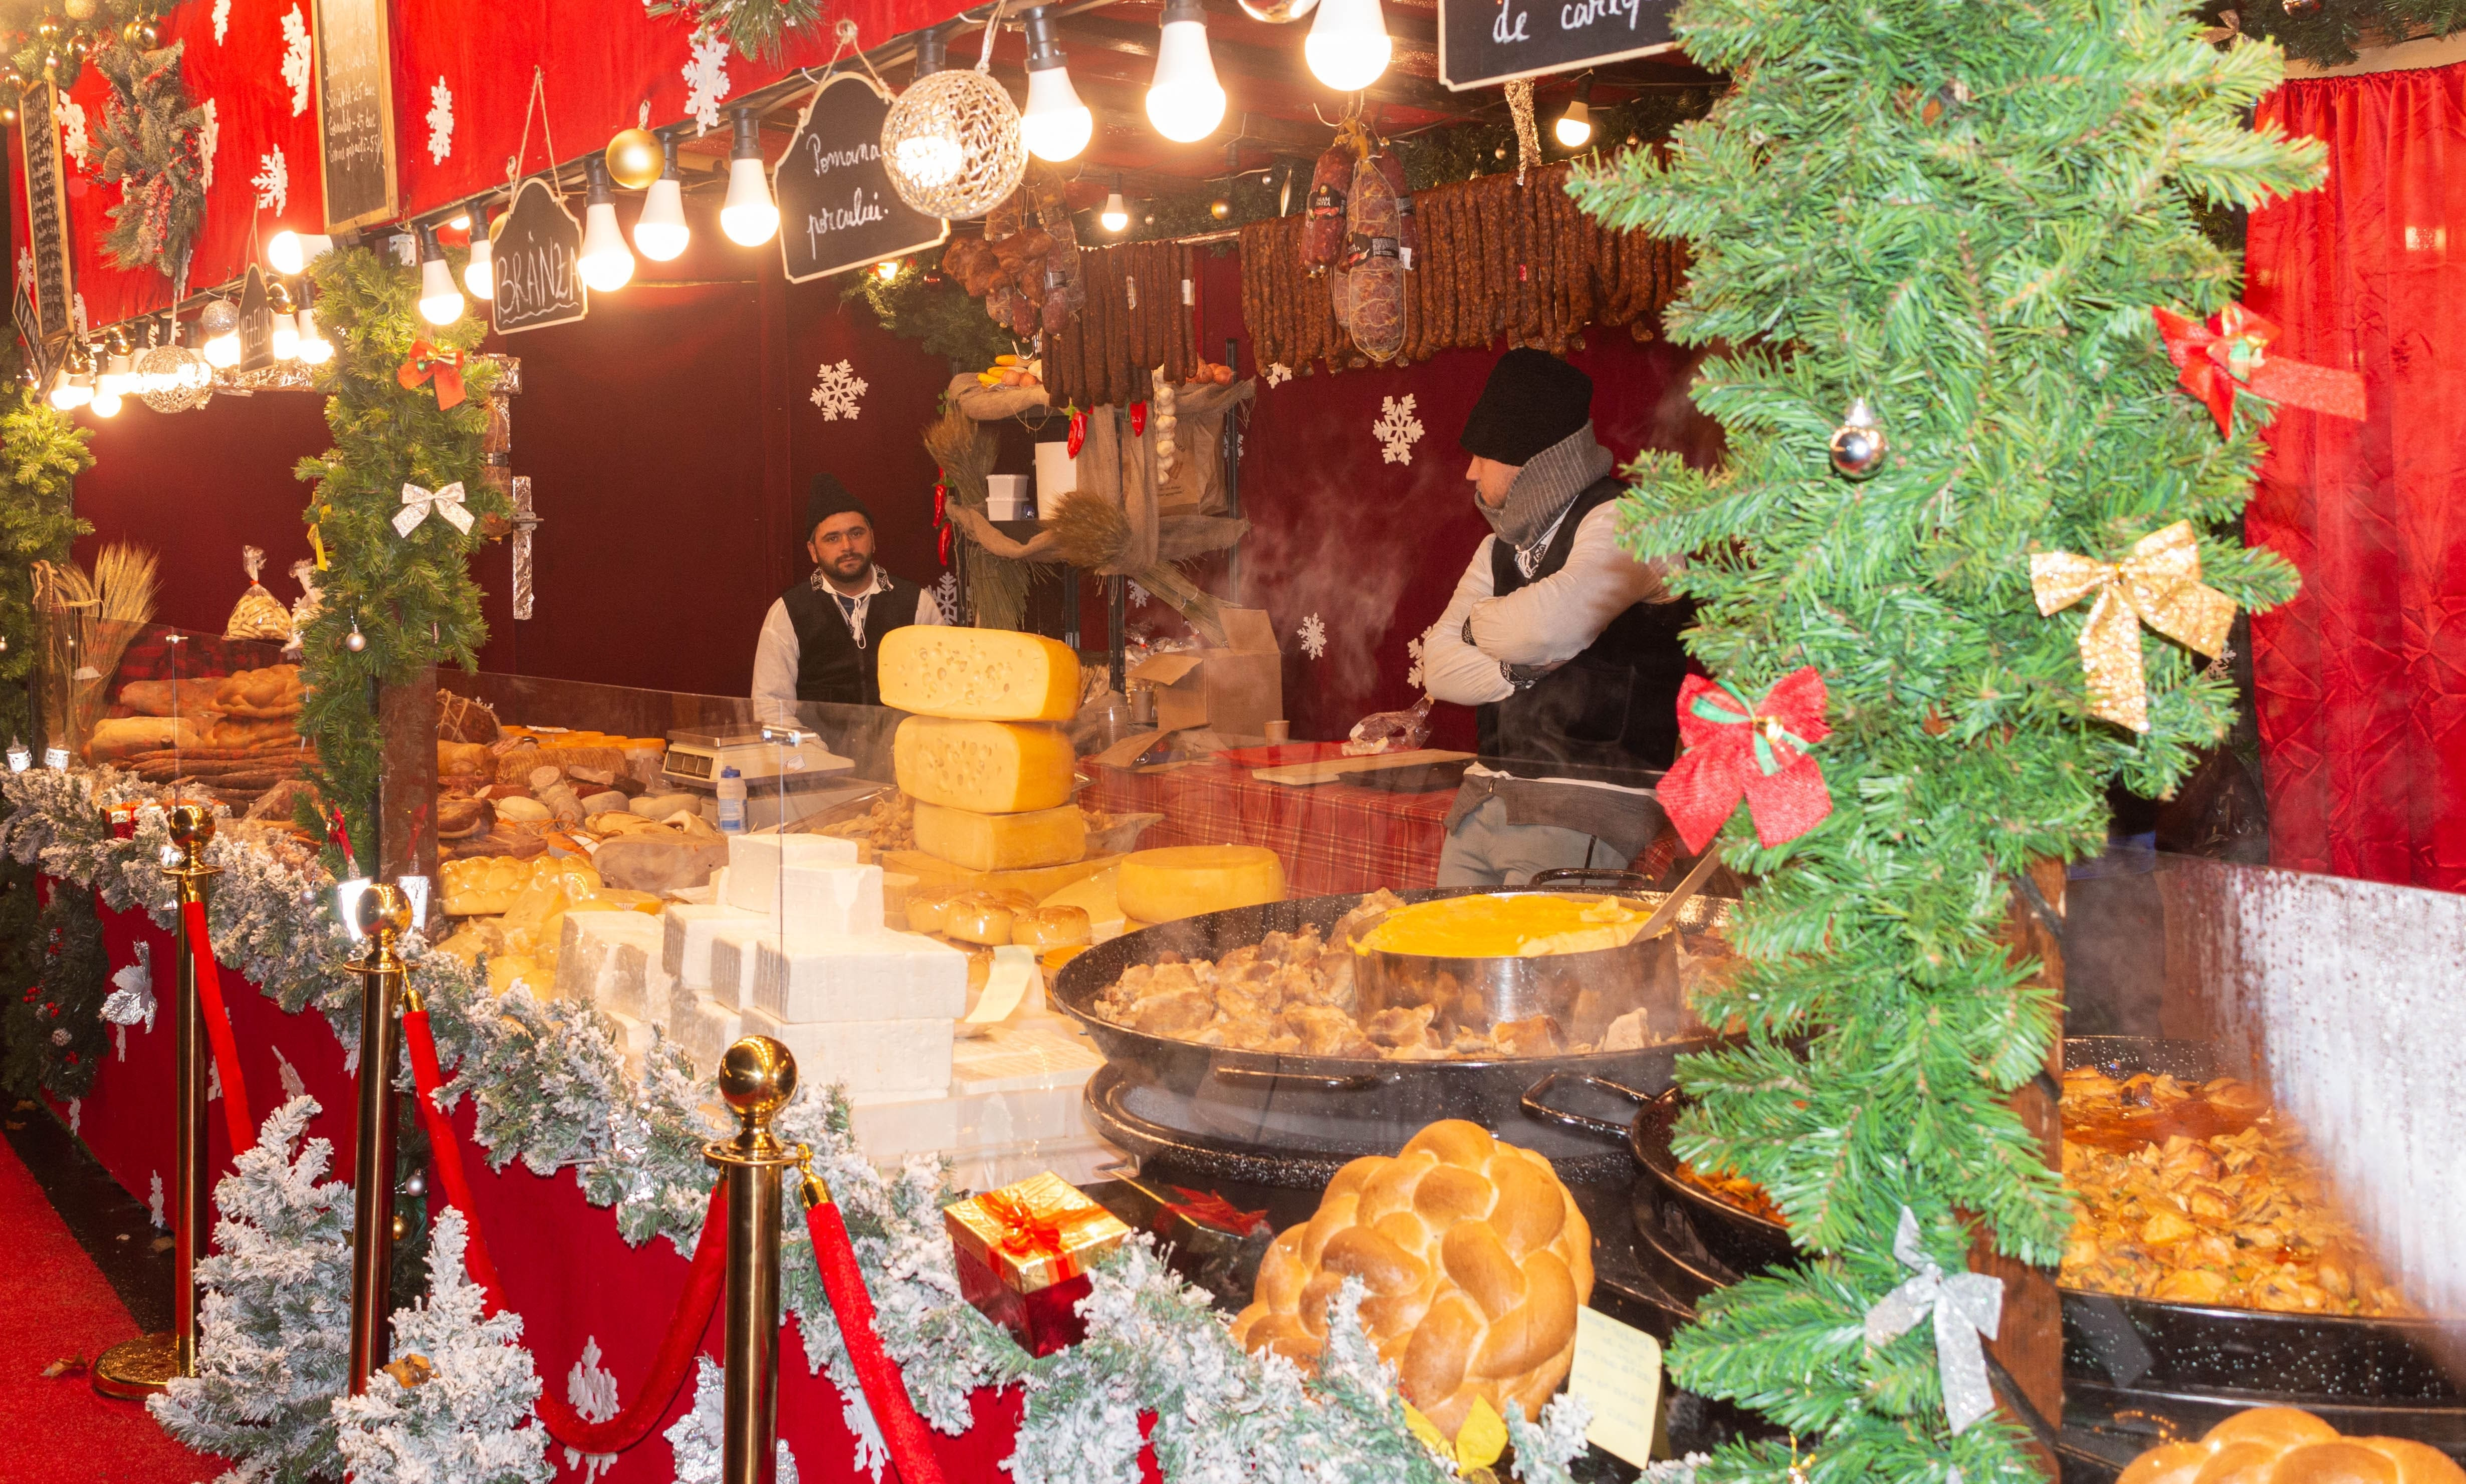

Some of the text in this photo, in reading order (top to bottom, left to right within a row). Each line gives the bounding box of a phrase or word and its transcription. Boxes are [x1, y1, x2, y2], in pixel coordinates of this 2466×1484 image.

[1493, 0, 1530, 44] de
[806, 133, 882, 177] Pomana
[806, 187, 888, 260] porcului.
